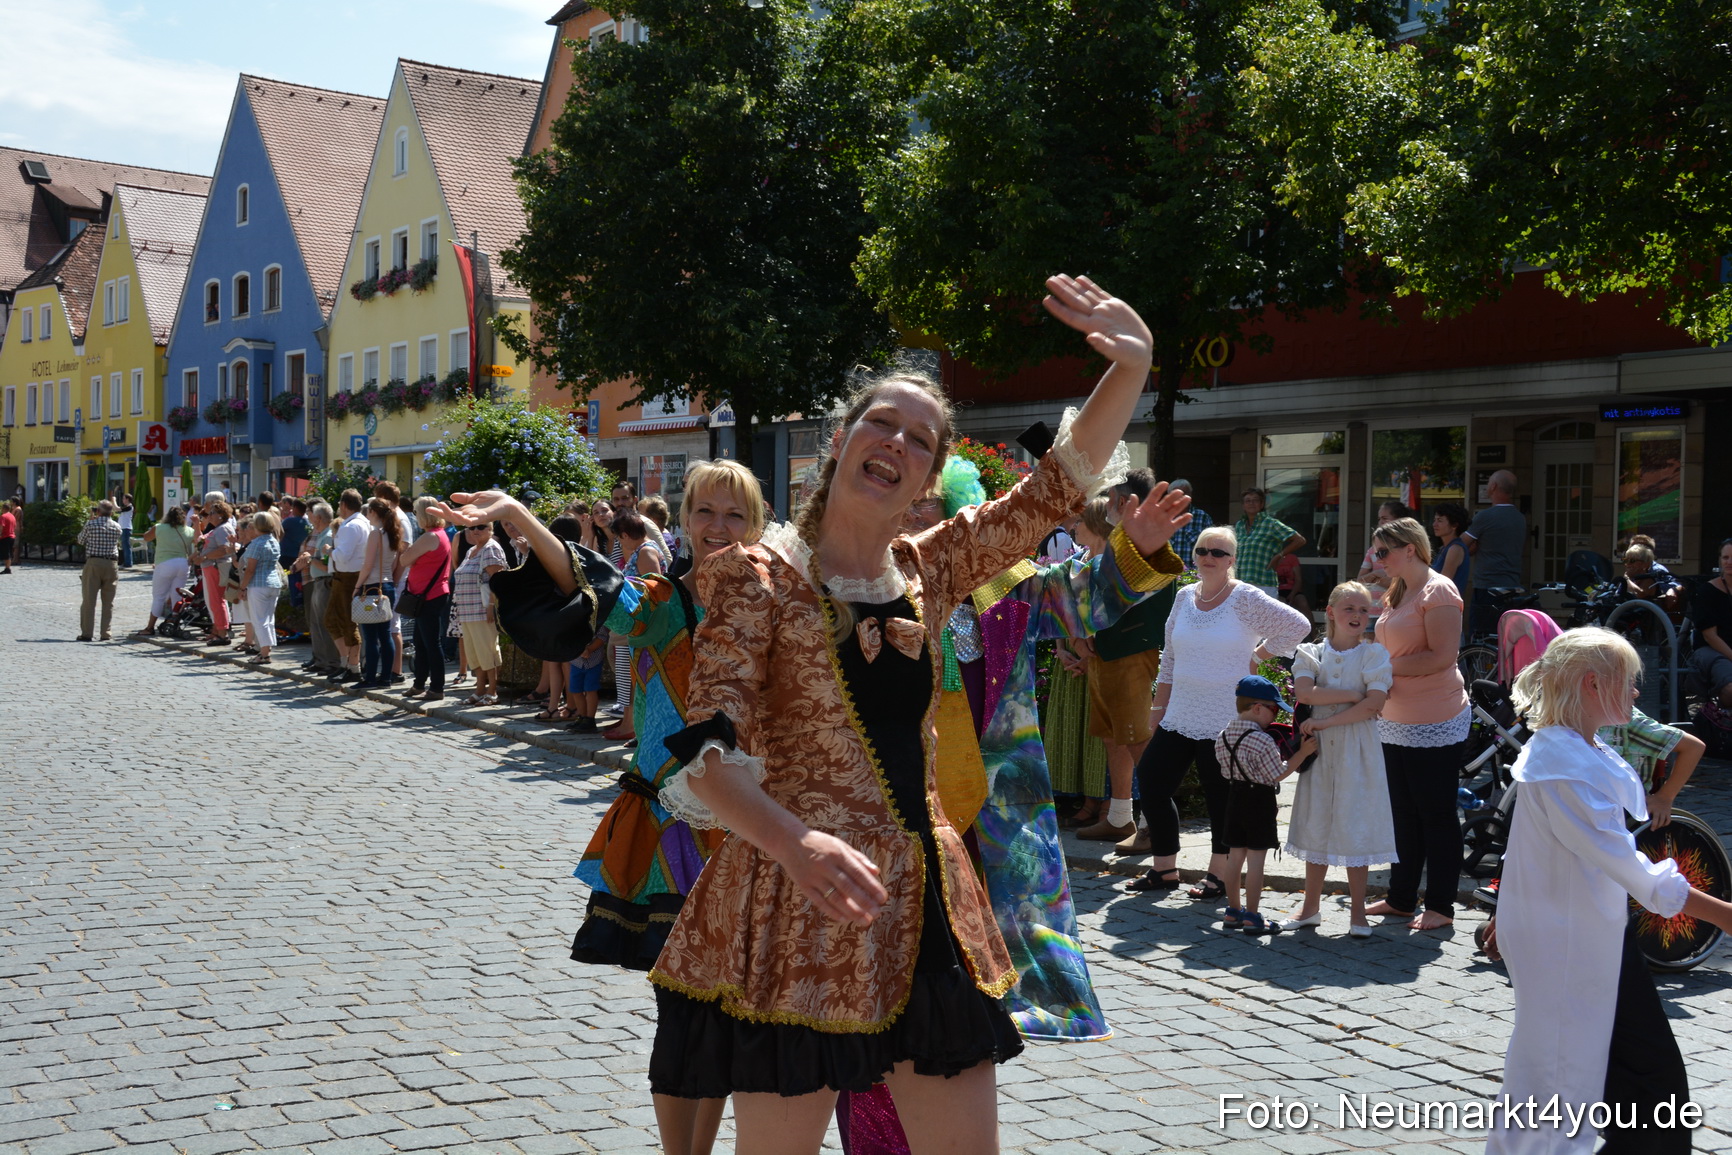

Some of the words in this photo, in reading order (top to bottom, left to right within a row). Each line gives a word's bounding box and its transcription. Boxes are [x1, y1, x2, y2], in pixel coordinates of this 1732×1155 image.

[32, 361, 52, 377] HOTEL
[590, 404, 597, 430] P
[1604, 408, 1620, 418] mit
[30, 443, 57, 454] Restaurant
[353, 438, 365, 458] P
